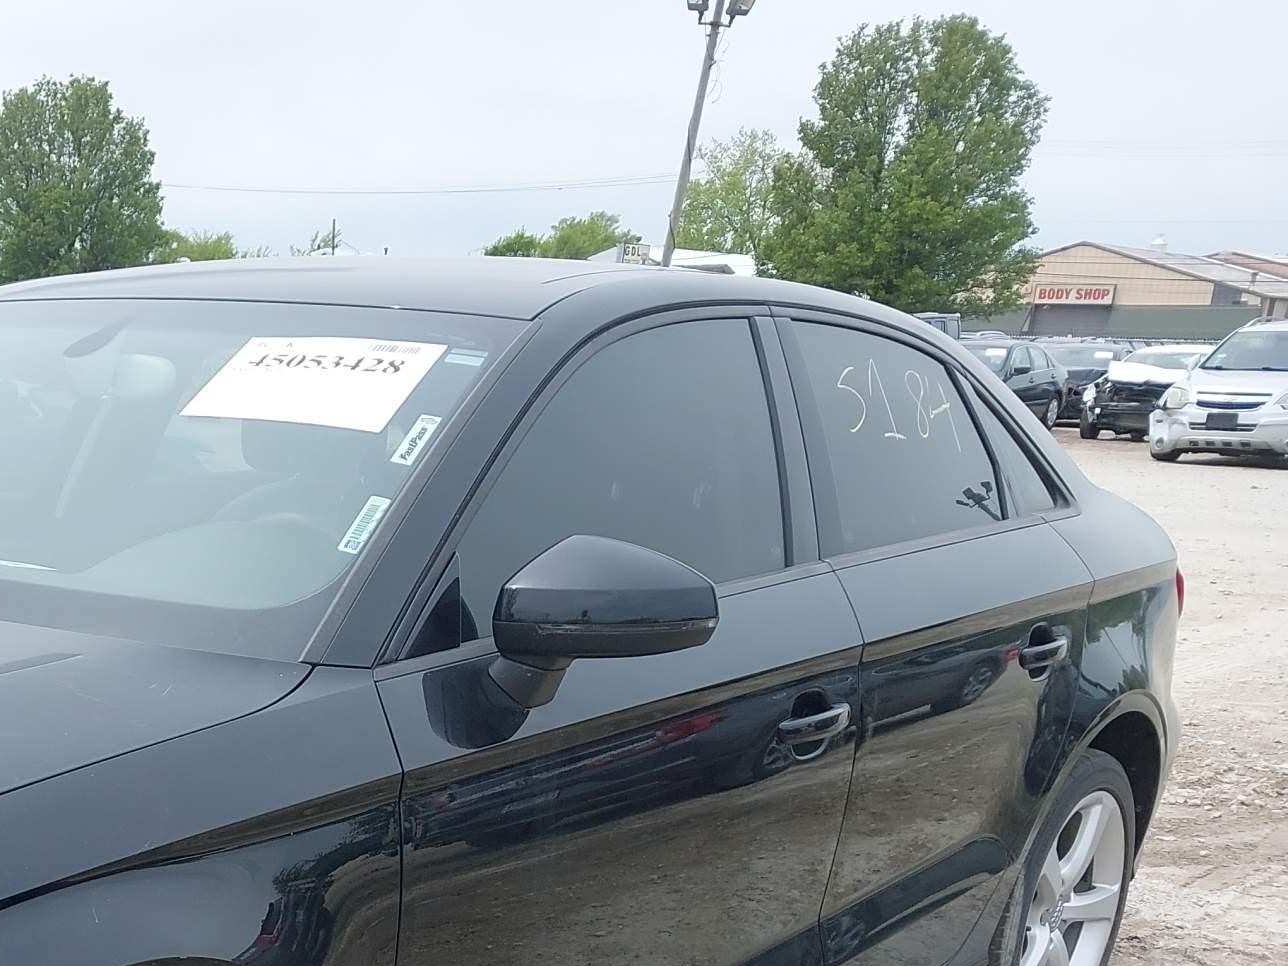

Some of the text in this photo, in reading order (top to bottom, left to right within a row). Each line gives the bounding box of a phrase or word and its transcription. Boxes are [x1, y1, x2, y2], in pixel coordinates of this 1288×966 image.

[1038, 287, 1110, 300] BODY SHOP
[248, 353, 405, 374] 45053428
[837, 358, 961, 453] 5184
[399, 427, 428, 461] FastPass
